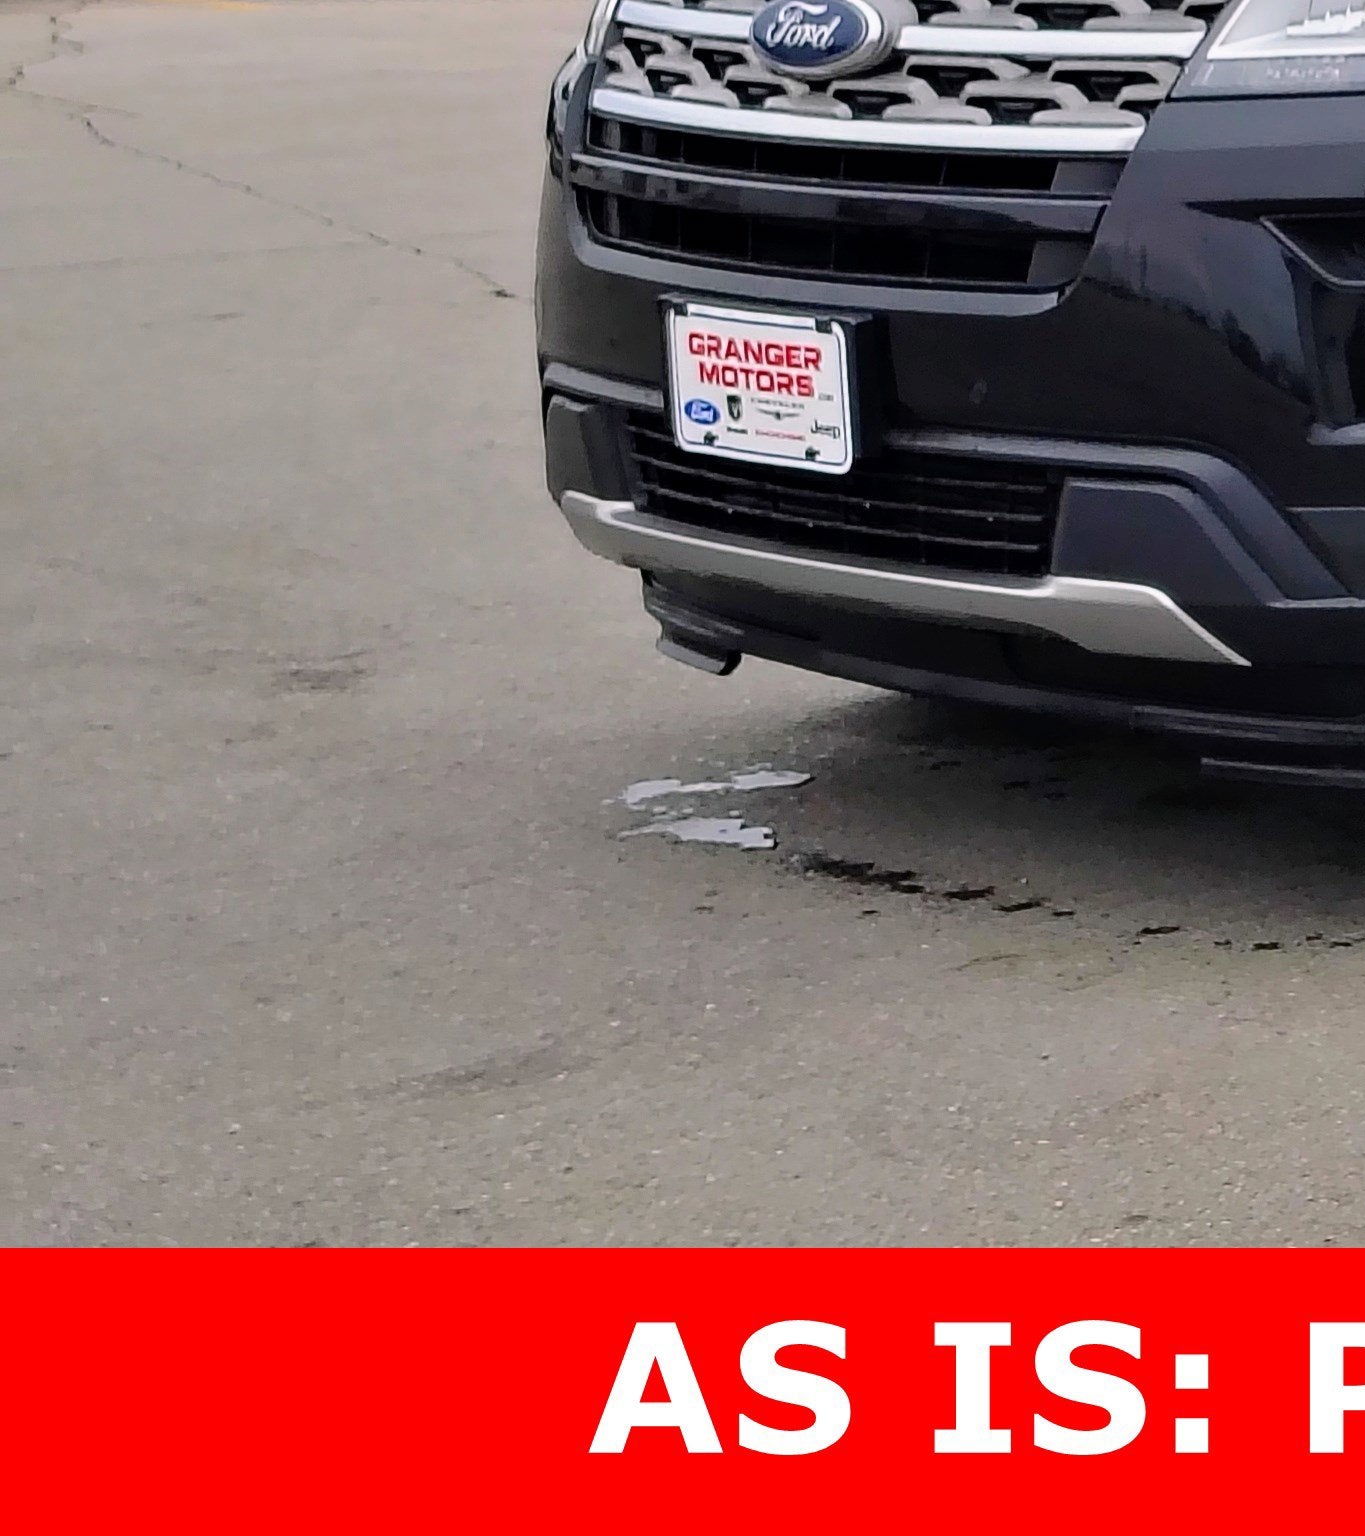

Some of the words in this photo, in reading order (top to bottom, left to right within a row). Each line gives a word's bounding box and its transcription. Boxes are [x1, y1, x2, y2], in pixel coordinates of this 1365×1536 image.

[766, 0, 841, 50] Ford
[688, 332, 822, 371] GRANGER
[699, 361, 815, 398] MOTORS
